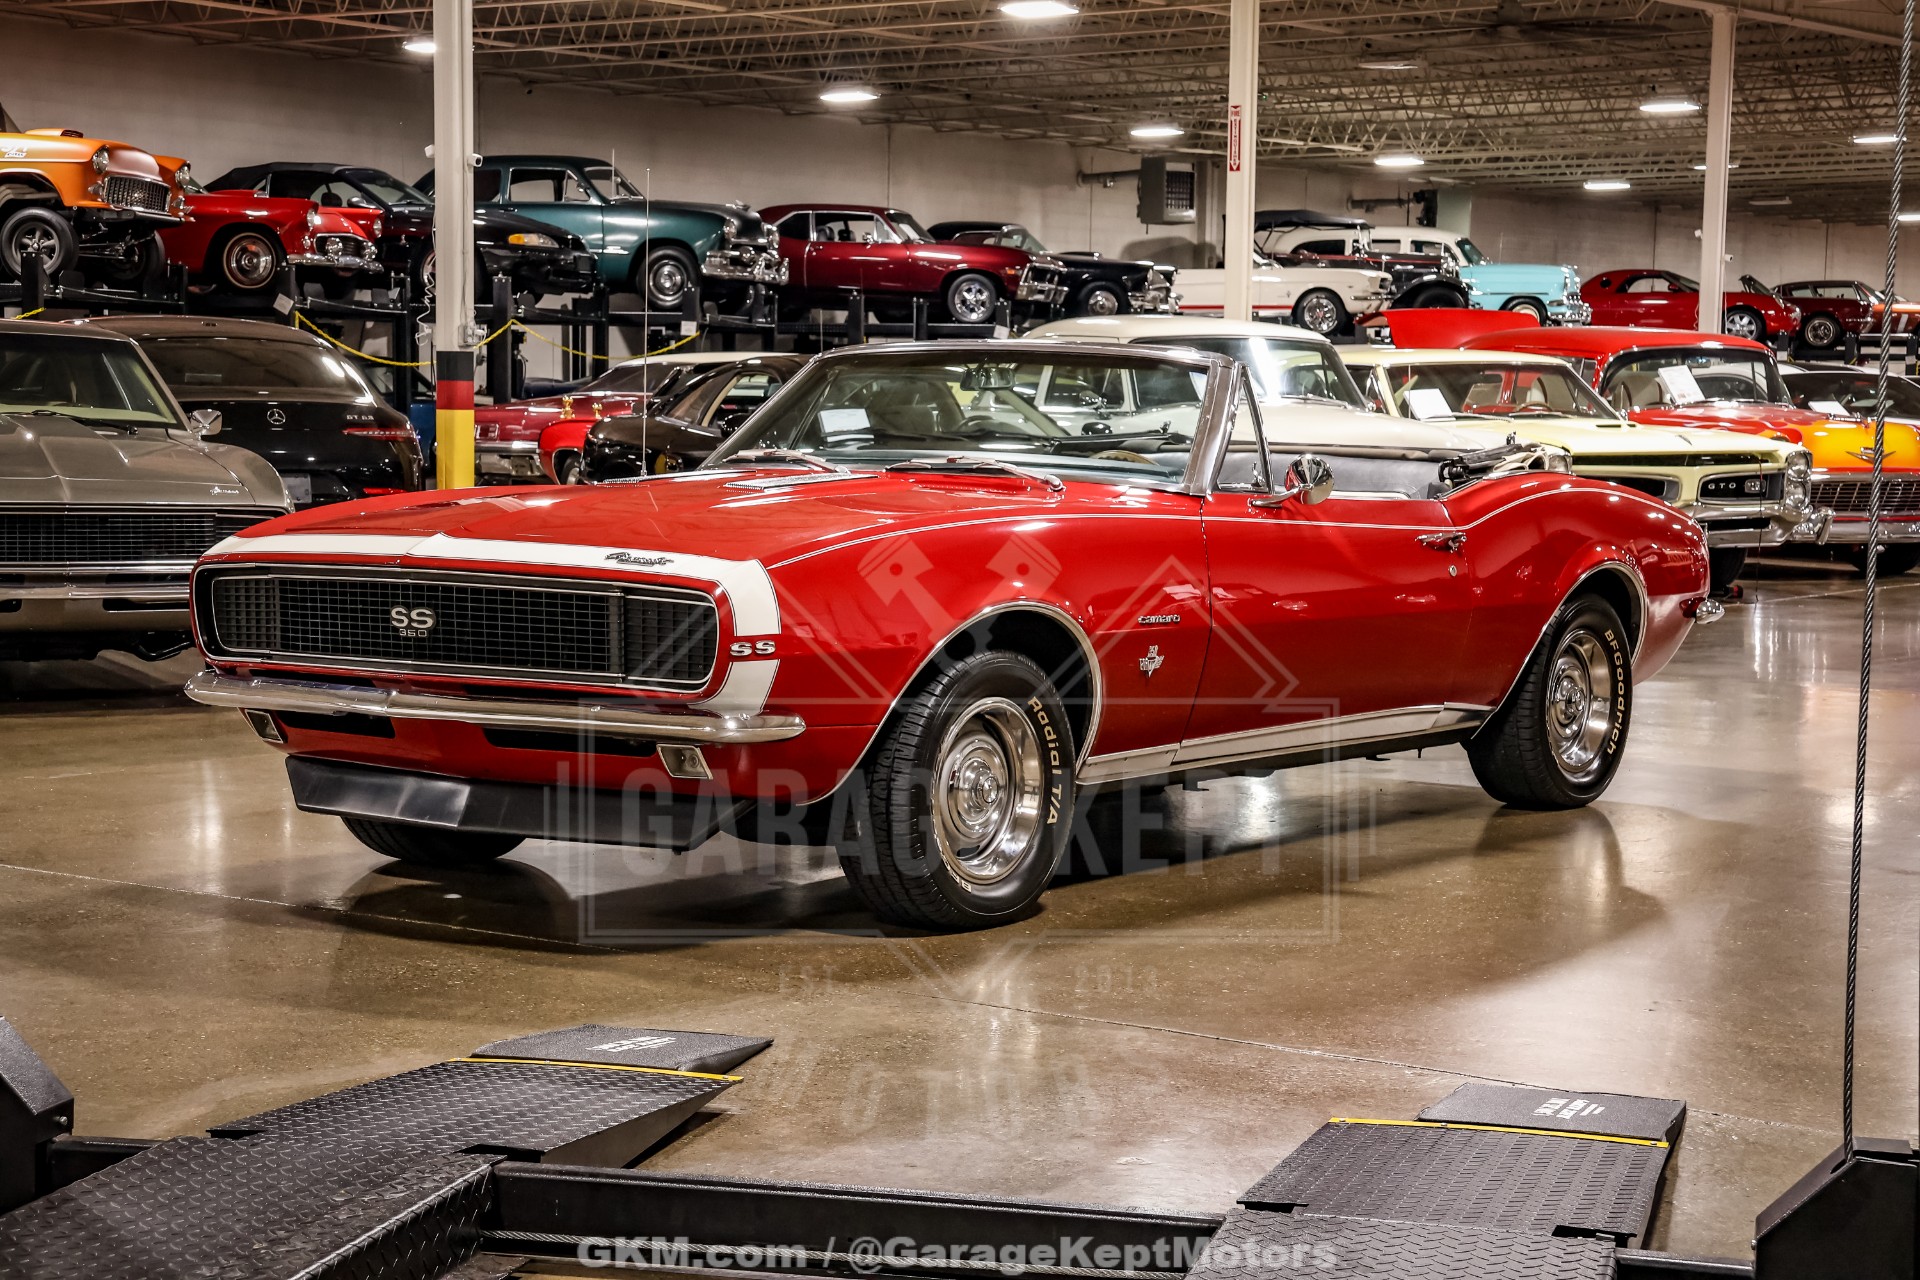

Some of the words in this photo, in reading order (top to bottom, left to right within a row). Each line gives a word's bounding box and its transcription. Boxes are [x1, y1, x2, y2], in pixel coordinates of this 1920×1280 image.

[1707, 482, 1737, 490] GTO
[391, 607, 434, 629] SS
[399, 628, 428, 637] 350
[729, 639, 776, 657] SS
[1027, 695, 1063, 776] Radial
[1046, 783, 1063, 825] T/A
